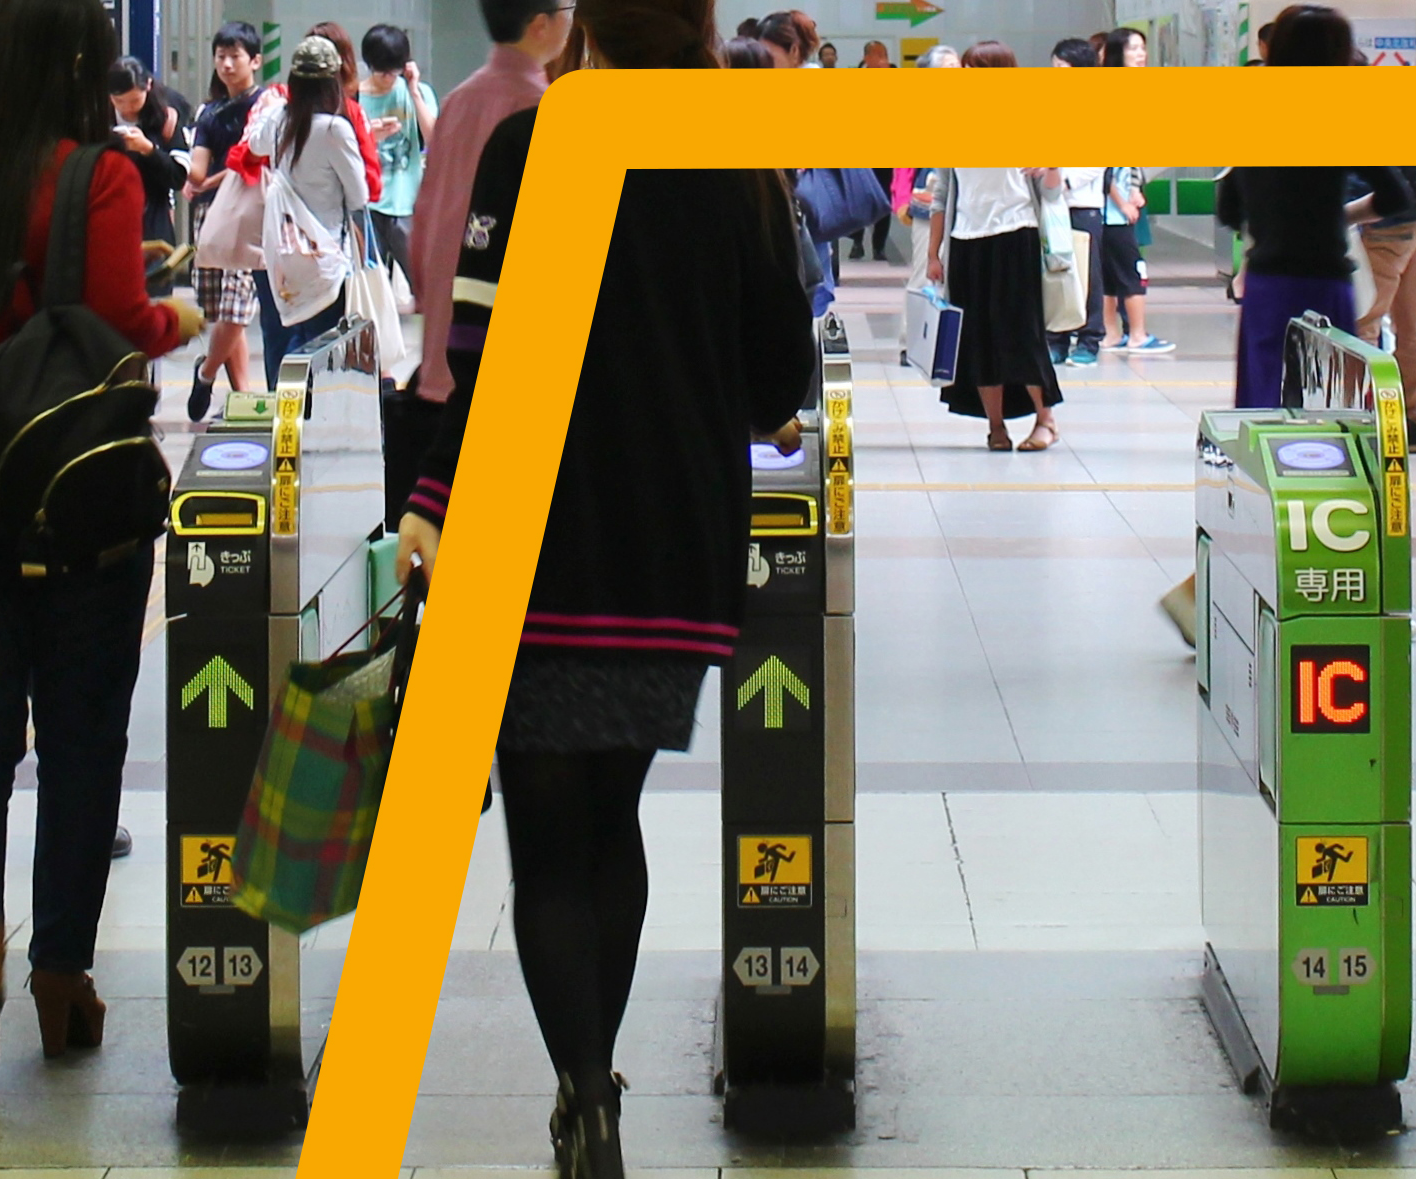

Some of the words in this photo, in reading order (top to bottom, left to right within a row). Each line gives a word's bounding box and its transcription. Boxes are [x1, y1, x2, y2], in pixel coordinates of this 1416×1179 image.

[1287, 499, 1371, 551] IC
[220, 550, 251, 564] きっぷ
[775, 550, 806, 564] きっぷ
[220, 565, 251, 574] TICKET
[1295, 567, 1365, 603] 専用
[1298, 661, 1366, 724] IC
[188, 953, 212, 976] 12
[228, 953, 252, 976] 13
[744, 954, 767, 978] 13
[785, 954, 809, 978] 14
[1301, 955, 1326, 979] 14
[1343, 955, 1367, 979] 15
